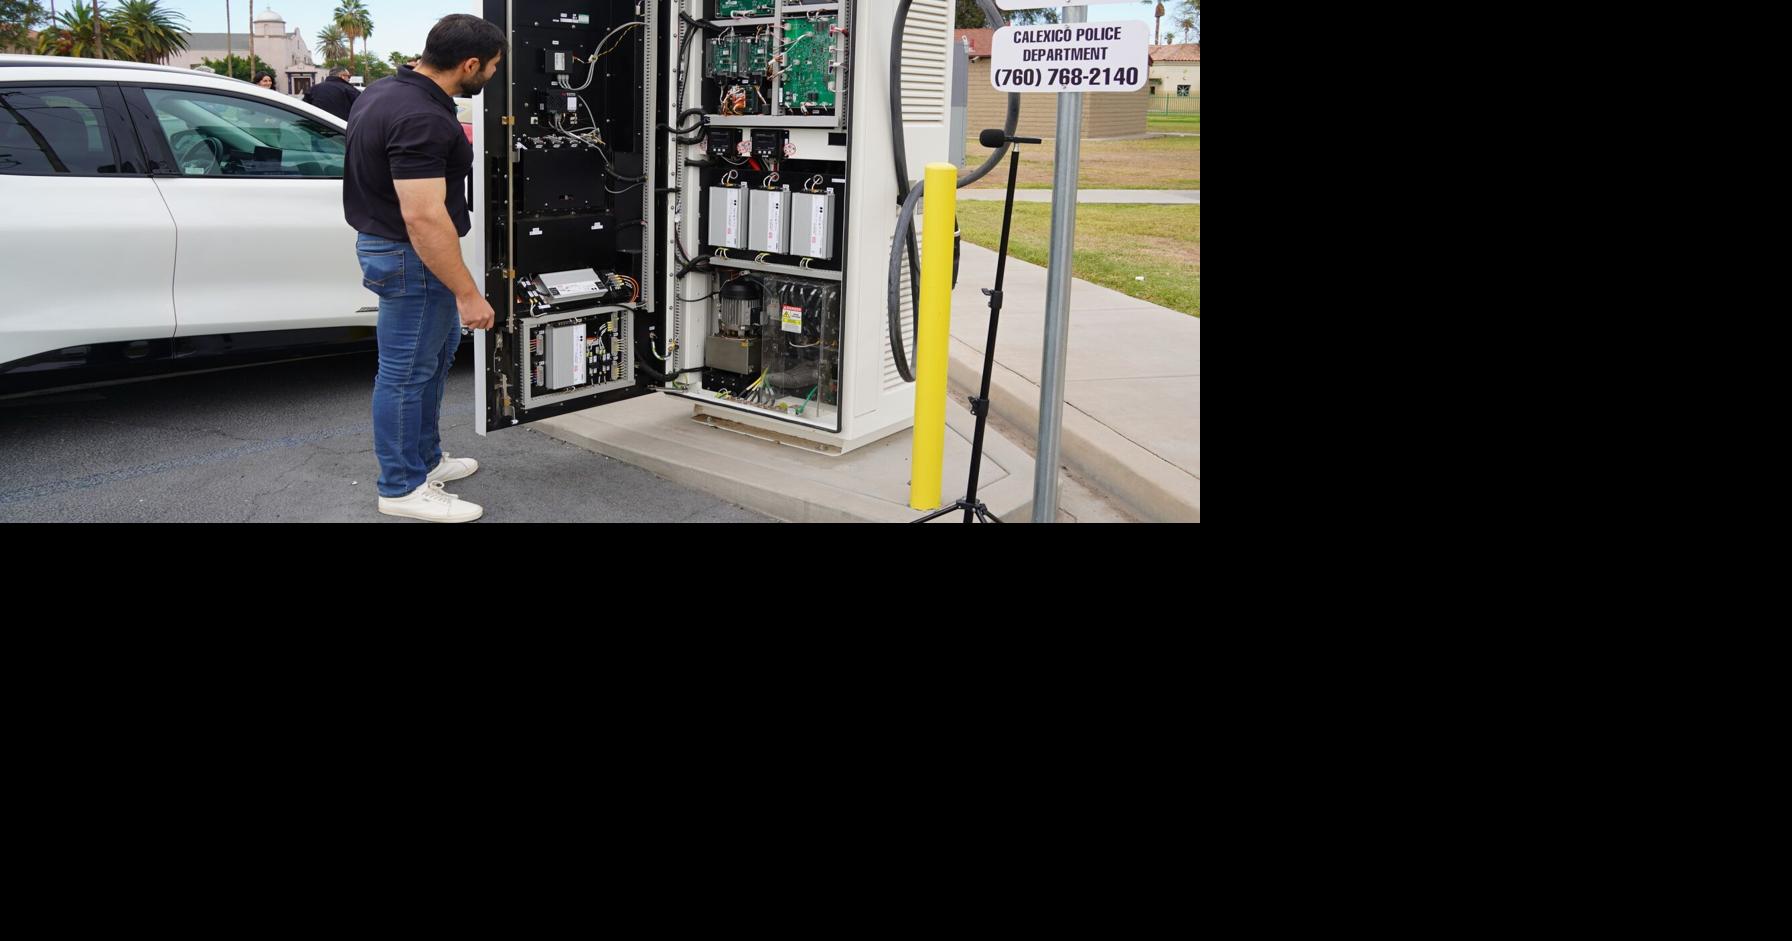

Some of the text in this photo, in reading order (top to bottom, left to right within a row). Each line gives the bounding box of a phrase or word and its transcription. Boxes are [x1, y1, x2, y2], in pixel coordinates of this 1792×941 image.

[1013, 27, 1121, 43] CALEXICO POLICE
[1023, 47, 1108, 62] DEPARTMENT
[995, 67, 1138, 87] (760) 768-2140
